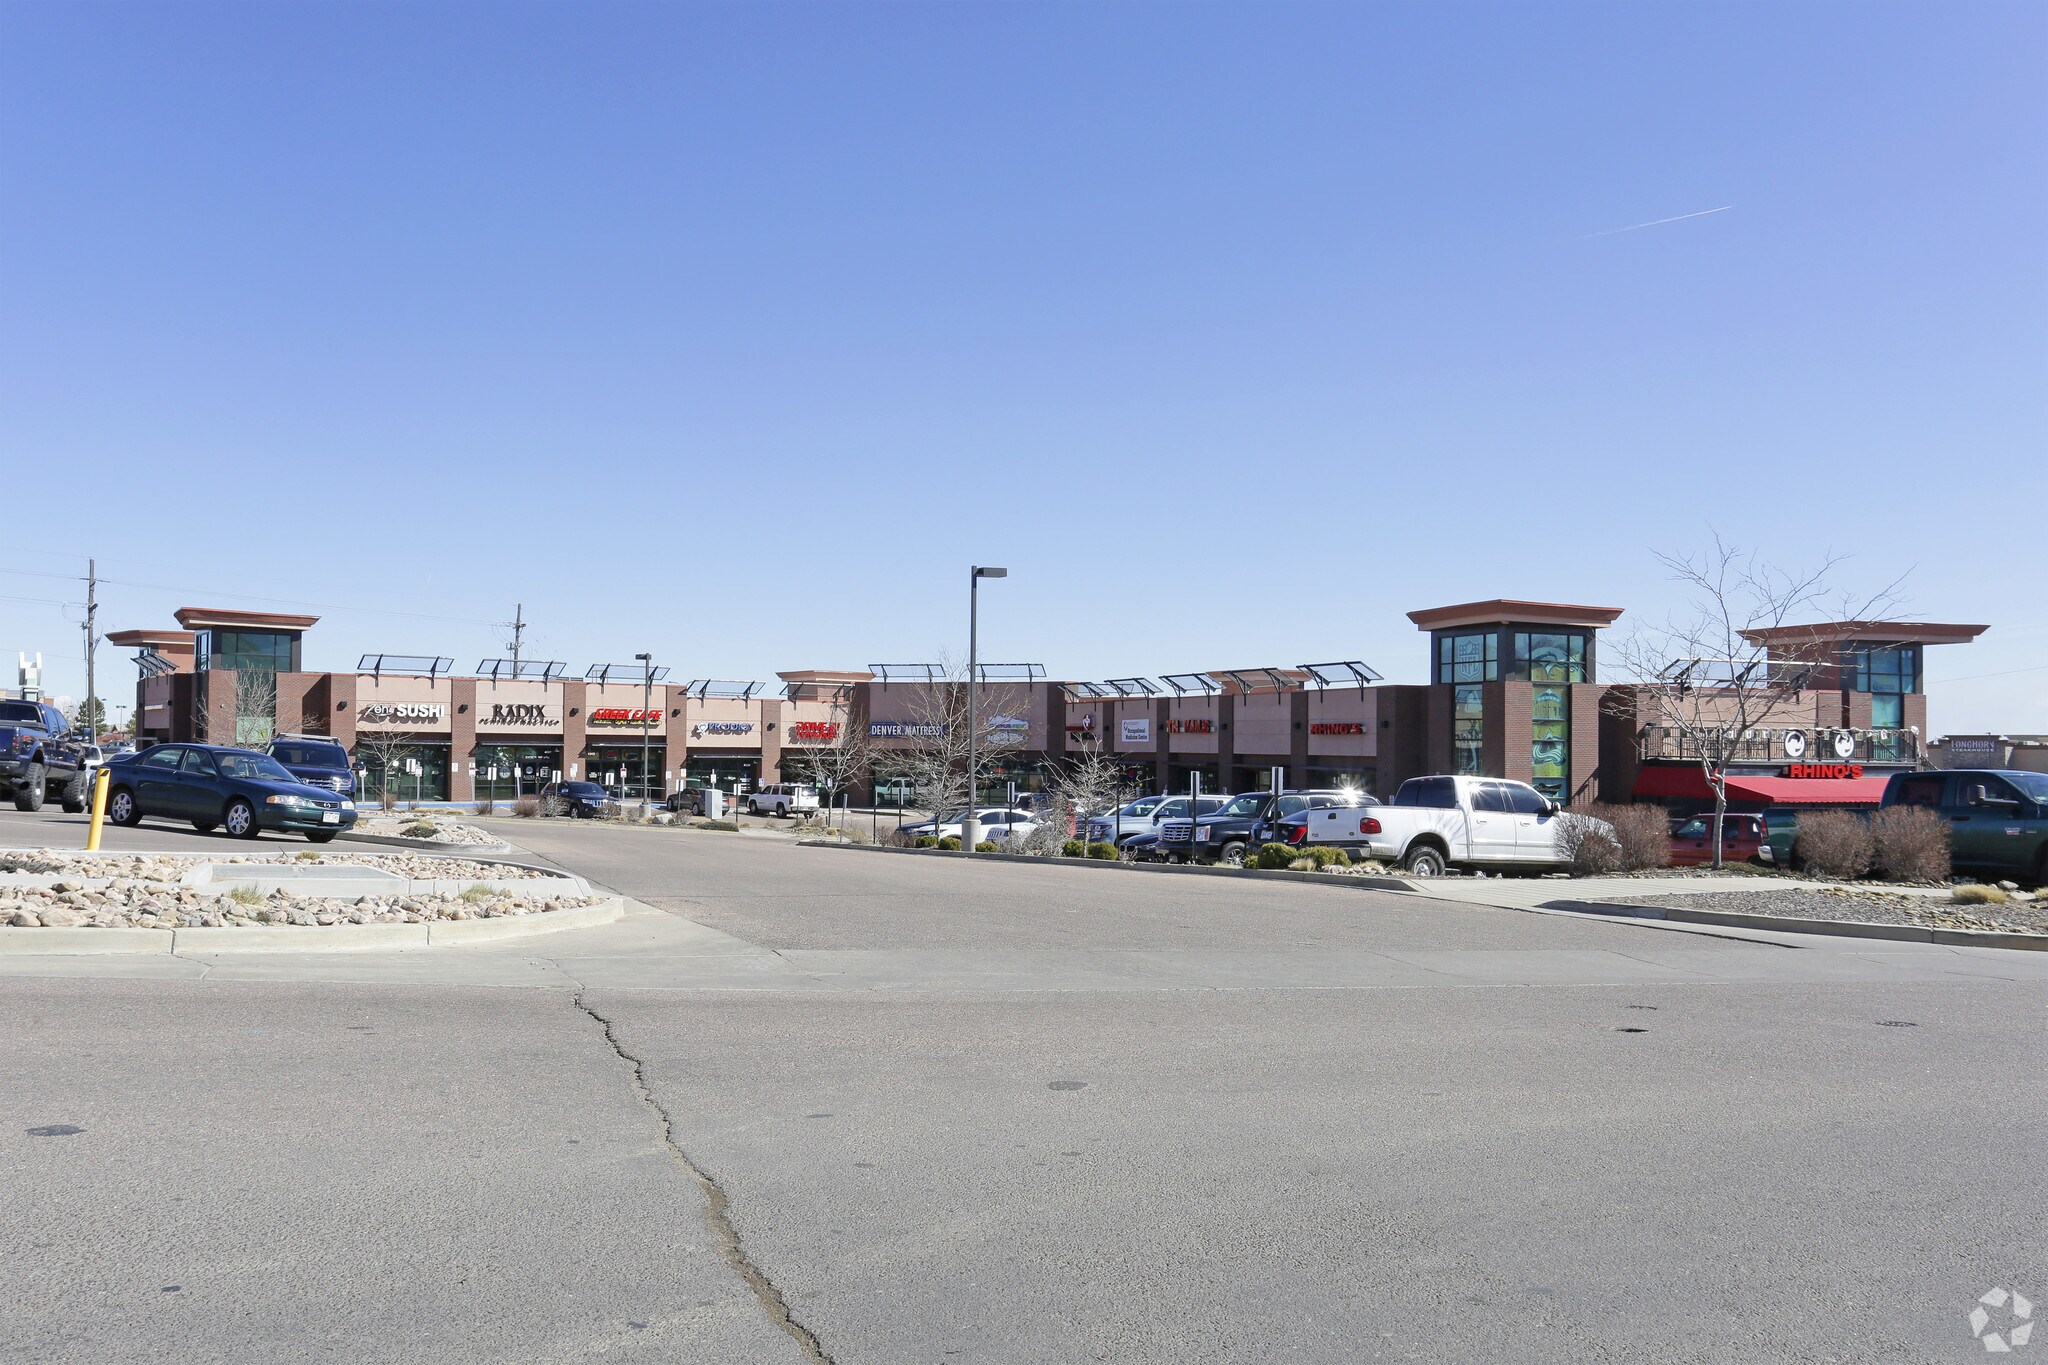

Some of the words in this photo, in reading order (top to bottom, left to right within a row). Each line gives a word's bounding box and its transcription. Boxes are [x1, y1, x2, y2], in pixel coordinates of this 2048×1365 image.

[1460, 656, 1479, 674] NFL
[396, 703, 445, 718] SUSHI
[491, 703, 546, 719] RADIX
[594, 708, 632, 720] GREEK
[632, 709, 664, 721] CAFE
[707, 722, 755, 731] PRODIGY
[871, 725, 902, 735] DENVER
[904, 725, 941, 735] MATTRESS
[1311, 723, 1362, 735] RHINO'S
[1951, 740, 1995, 749] LONGHORN
[1790, 764, 1864, 779] RHINO'S
